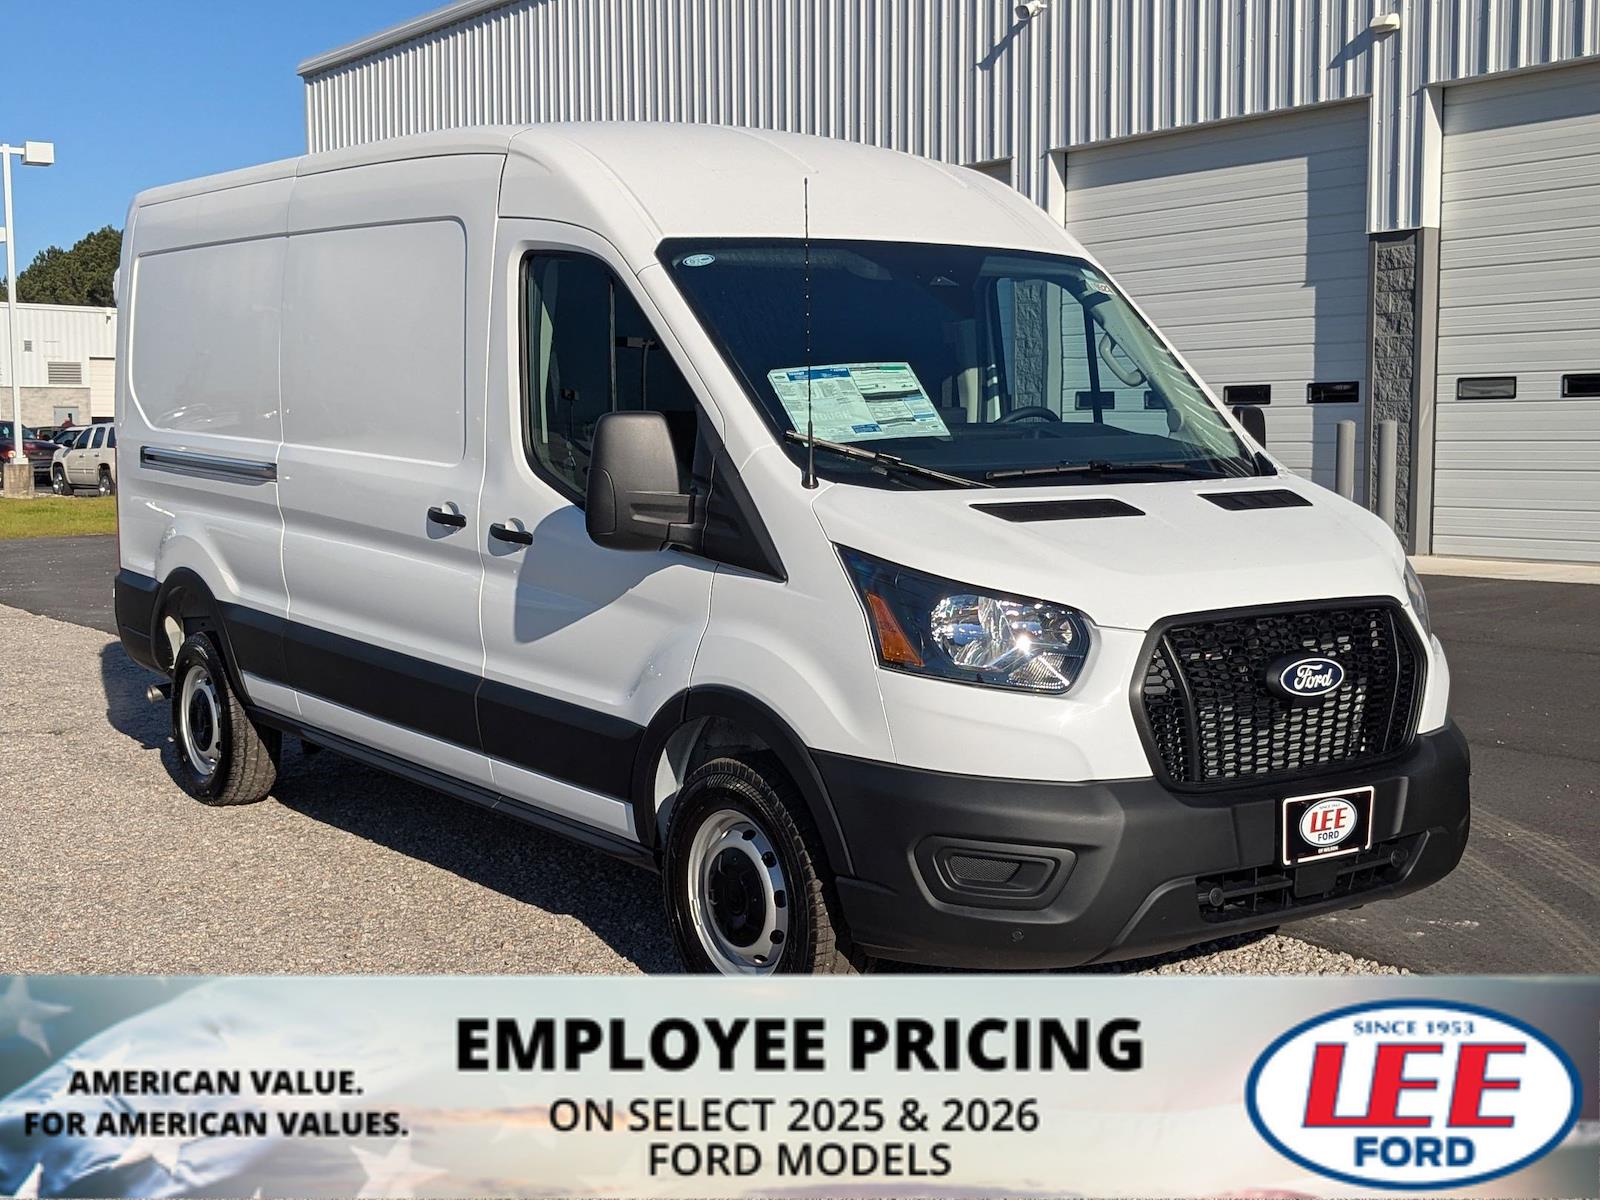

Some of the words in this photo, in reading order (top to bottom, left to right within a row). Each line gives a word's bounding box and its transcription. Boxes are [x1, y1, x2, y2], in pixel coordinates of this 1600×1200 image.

[1294, 664, 1333, 689] Ford
[1310, 807, 1348, 833] LEE
[1318, 830, 1339, 842] FORD
